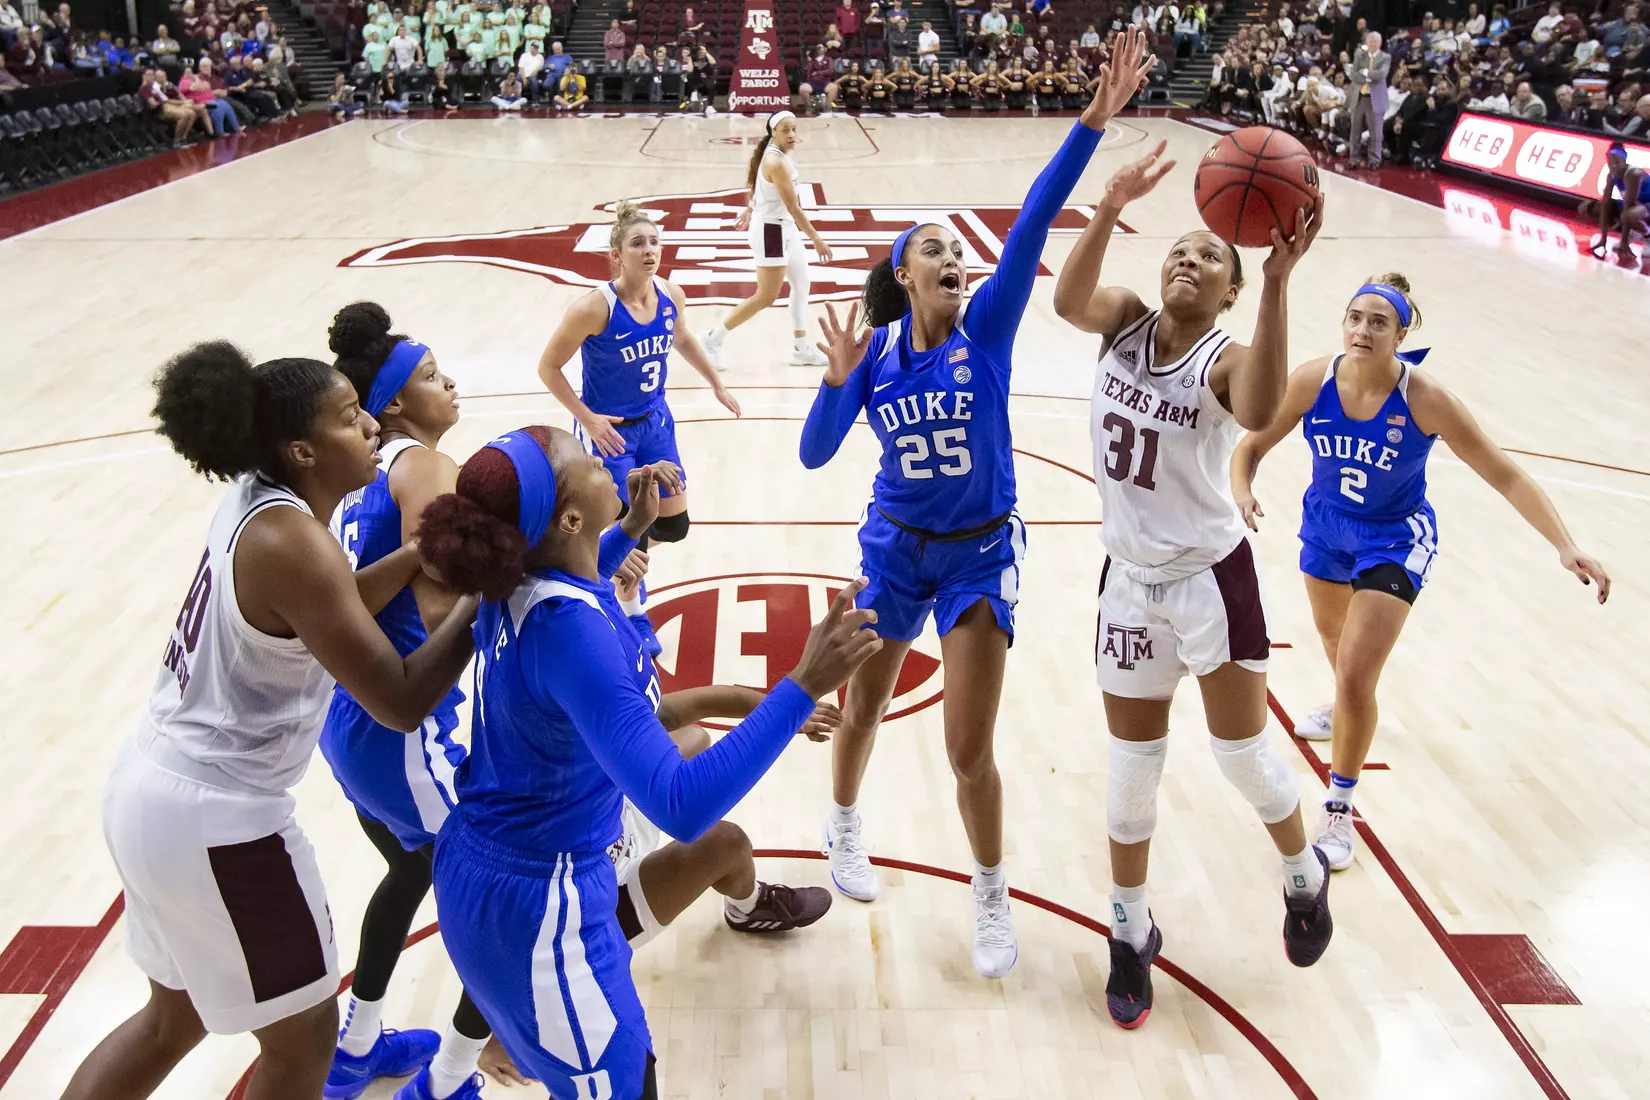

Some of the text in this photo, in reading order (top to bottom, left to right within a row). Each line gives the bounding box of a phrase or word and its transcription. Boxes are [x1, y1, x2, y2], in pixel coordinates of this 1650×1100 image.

[739, 69, 780, 78] WELLS
[741, 79, 779, 88] FARGO
[620, 334, 674, 363] DUKE
[640, 360, 661, 393] 3
[877, 391, 974, 433] DUKE
[1152, 399, 1200, 429] A&M
[895, 427, 972, 479] 25
[1102, 411, 1160, 491] 31
[1313, 434, 1399, 472] DUKE
[1339, 466, 1368, 504] 2
